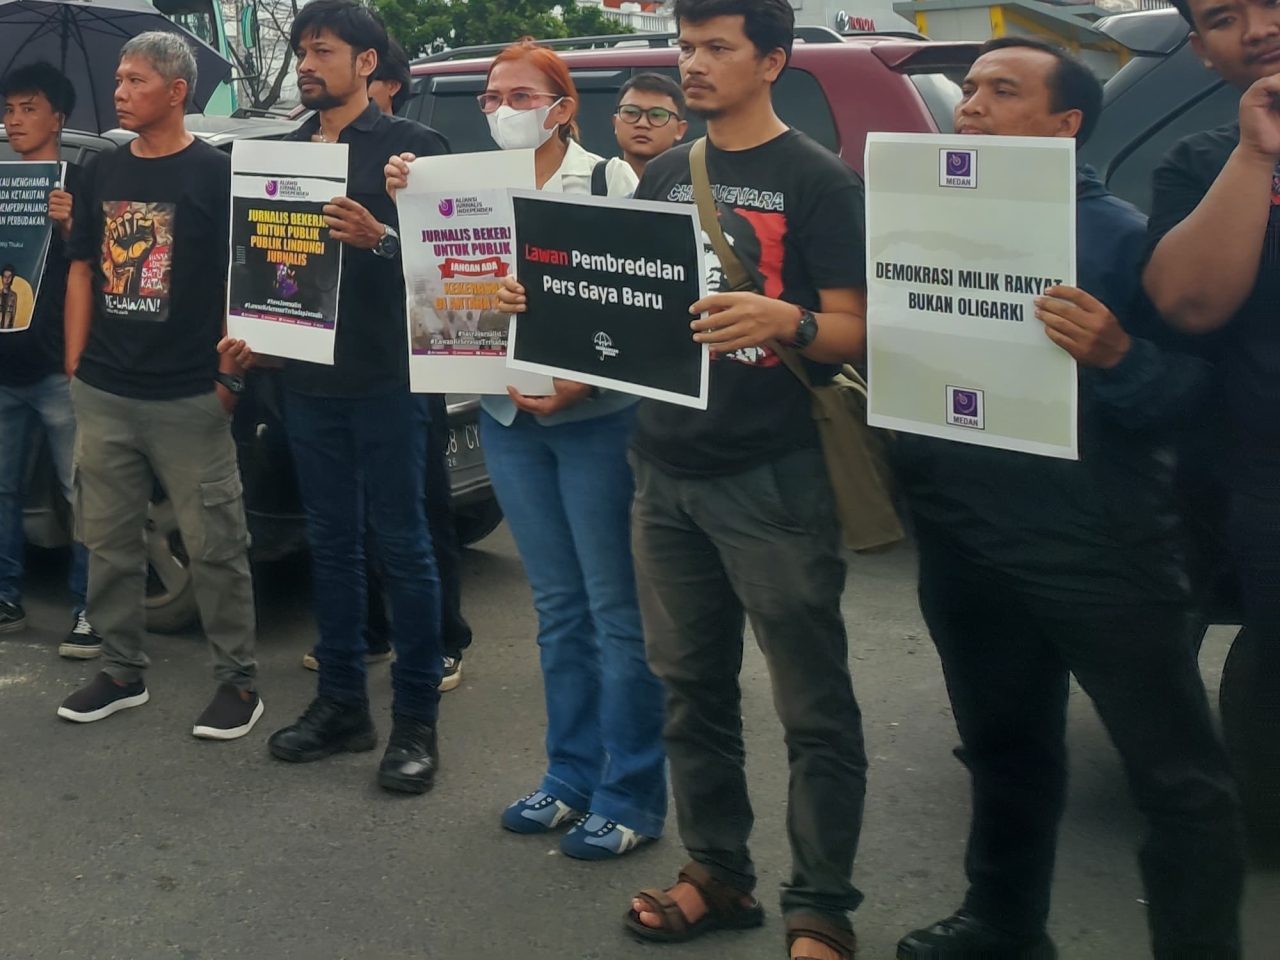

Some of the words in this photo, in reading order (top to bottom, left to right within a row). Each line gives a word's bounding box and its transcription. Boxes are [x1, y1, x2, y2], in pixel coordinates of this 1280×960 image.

[11, 177, 49, 187] MENGHAMBA
[946, 177, 971, 186] MEDAN
[11, 190, 45, 200] KETAKUTAN
[248, 209, 288, 224] JURNALIS
[257, 223, 286, 237] UNTUK
[287, 225, 320, 240] PUBLIK
[422, 229, 471, 242] JURNALIS
[473, 227, 511, 241] BEKERJ
[251, 235, 281, 249] PUBLIK
[283, 238, 325, 255] LINDUNGI
[434, 243, 470, 256] UNTUK
[472, 241, 511, 255] PUBLIK
[267, 250, 307, 266] JURNALIS
[525, 244, 568, 265] Lawan
[572, 250, 684, 281] Pembredelan
[141, 267, 162, 279] SATU
[451, 262, 480, 272] JANGAN
[481, 261, 498, 271] ADA
[141, 278, 163, 290] KATA
[876, 262, 953, 287] DEMOKRASI
[959, 270, 998, 291] MILIK
[543, 275, 575, 296] Pers
[579, 281, 618, 304] Gaya
[622, 287, 663, 310] Baru
[909, 292, 952, 313] BUKAN
[958, 297, 1023, 321] OLIGARKI
[953, 415, 978, 426] MEDAN
